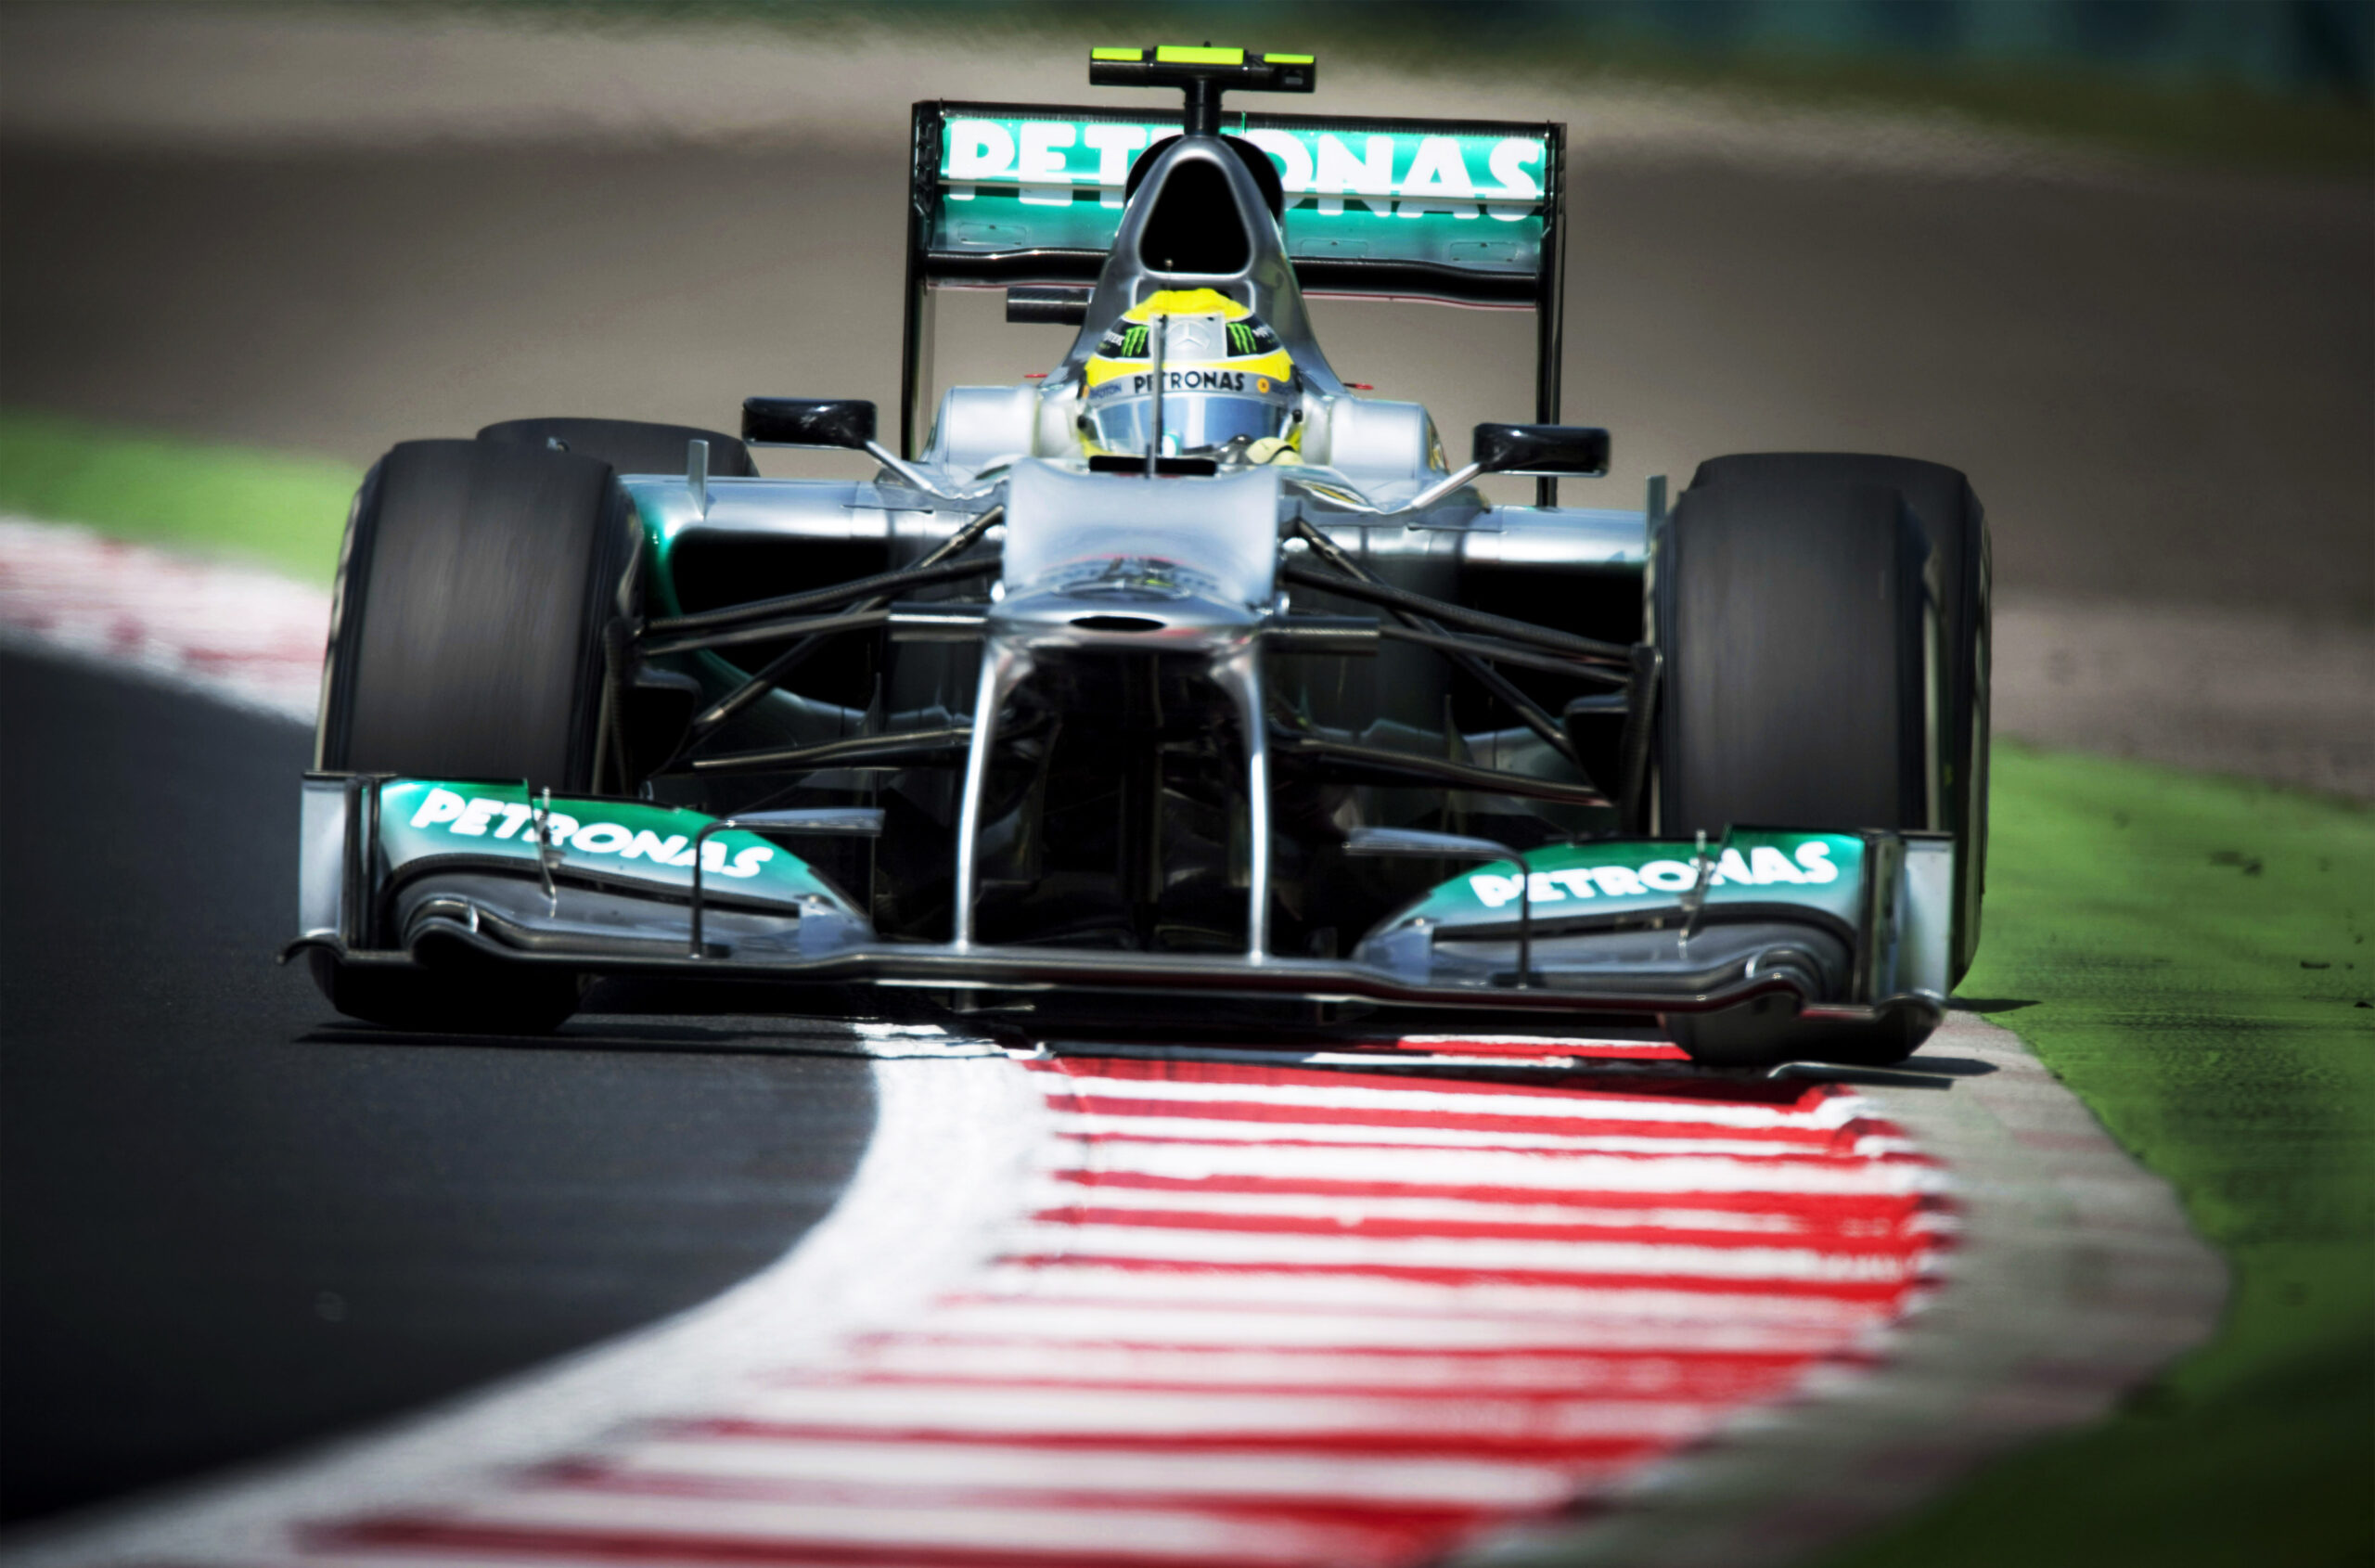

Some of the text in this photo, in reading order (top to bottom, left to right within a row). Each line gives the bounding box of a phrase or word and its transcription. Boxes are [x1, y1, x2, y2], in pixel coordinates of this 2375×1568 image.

[948, 120, 1540, 222] PETONAS
[1134, 371, 1244, 393] PERONAS
[410, 788, 774, 878] PETRONAS
[1469, 842, 1839, 907] PETRONAS
